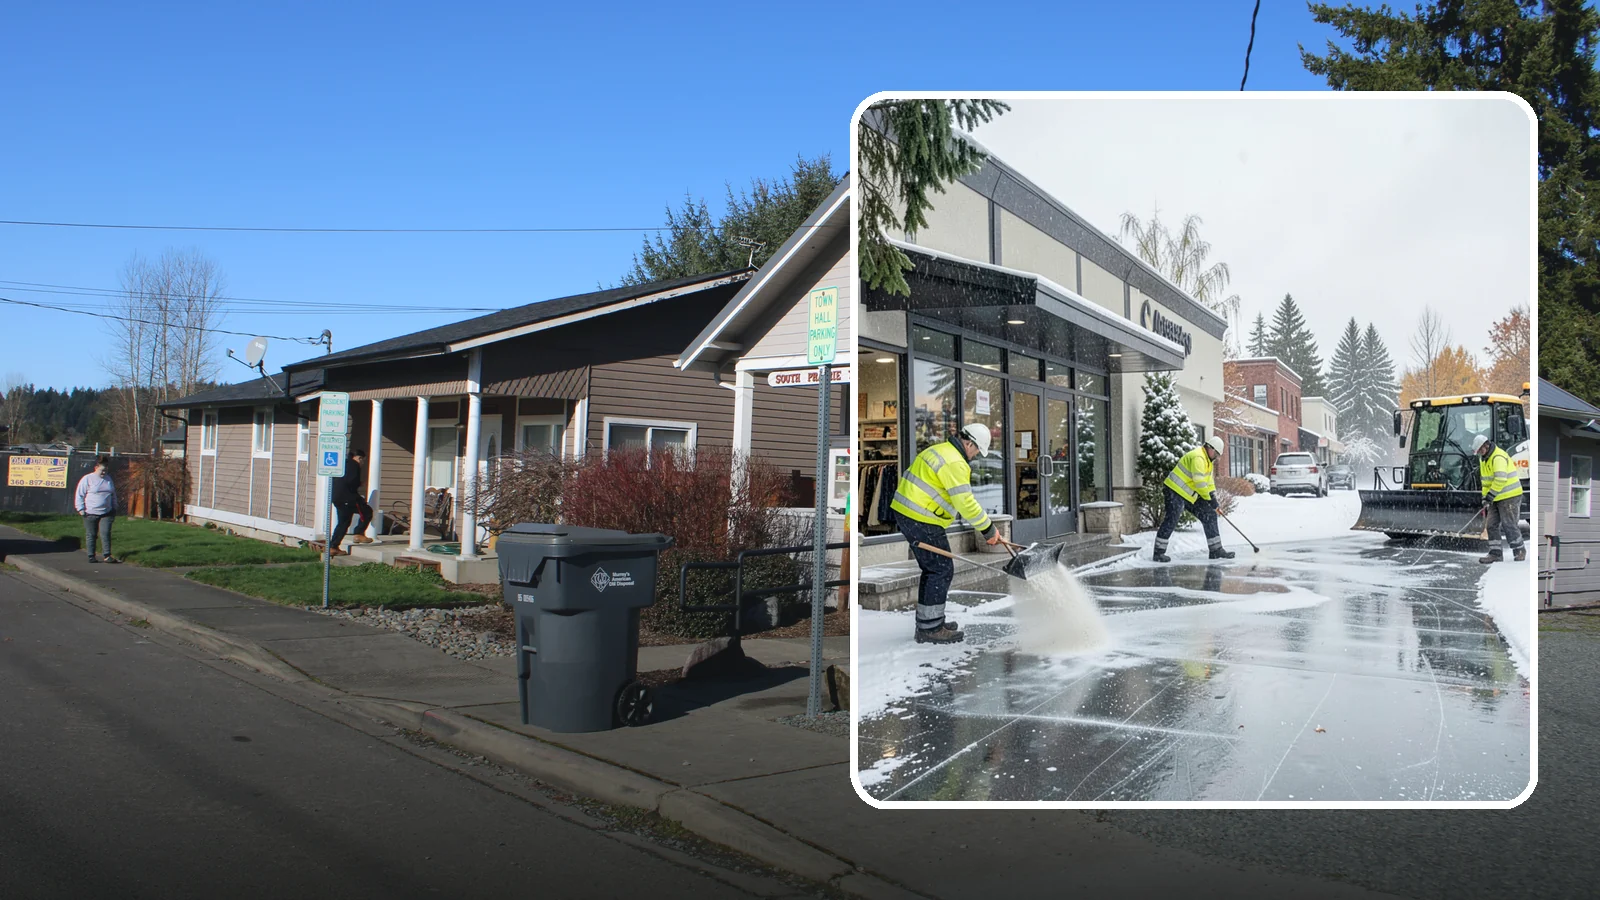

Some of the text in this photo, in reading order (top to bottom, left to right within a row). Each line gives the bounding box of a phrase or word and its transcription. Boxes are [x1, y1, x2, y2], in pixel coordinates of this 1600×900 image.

[815, 294, 833, 308] TOWN
[814, 311, 831, 324] HALL
[810, 327, 836, 340] PARKING
[813, 344, 831, 357] ONLY
[775, 373, 801, 384] SOUTH
